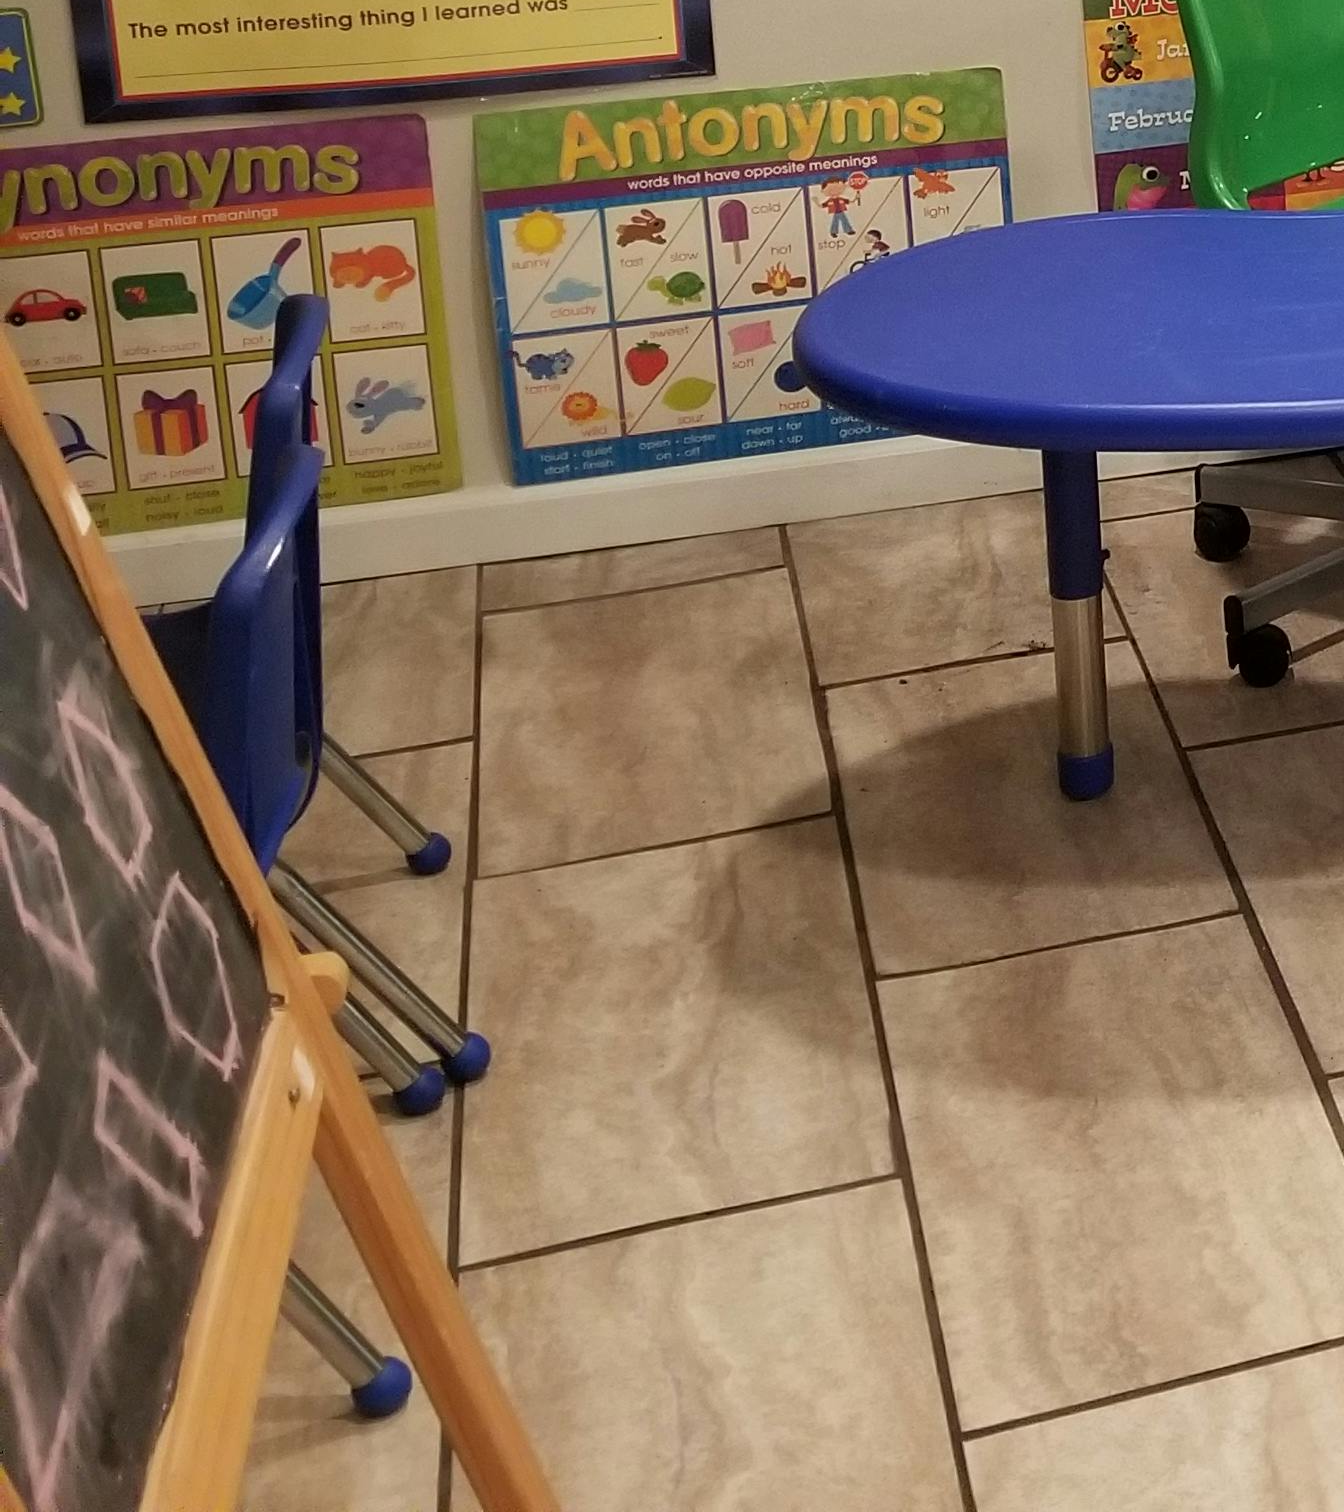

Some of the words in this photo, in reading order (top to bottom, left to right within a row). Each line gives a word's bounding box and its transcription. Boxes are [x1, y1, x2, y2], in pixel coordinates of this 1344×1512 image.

[127, 20, 170, 40] The
[174, 16, 231, 36] most
[235, 8, 354, 37] interesting
[358, 4, 416, 30] thing
[558, 93, 946, 182] Antonyms
[626, 174, 670, 192] words
[672, 170, 702, 187] that
[704, 166, 741, 184] have
[743, 159, 806, 182] opposite
[807, 152, 879, 175] meanings
